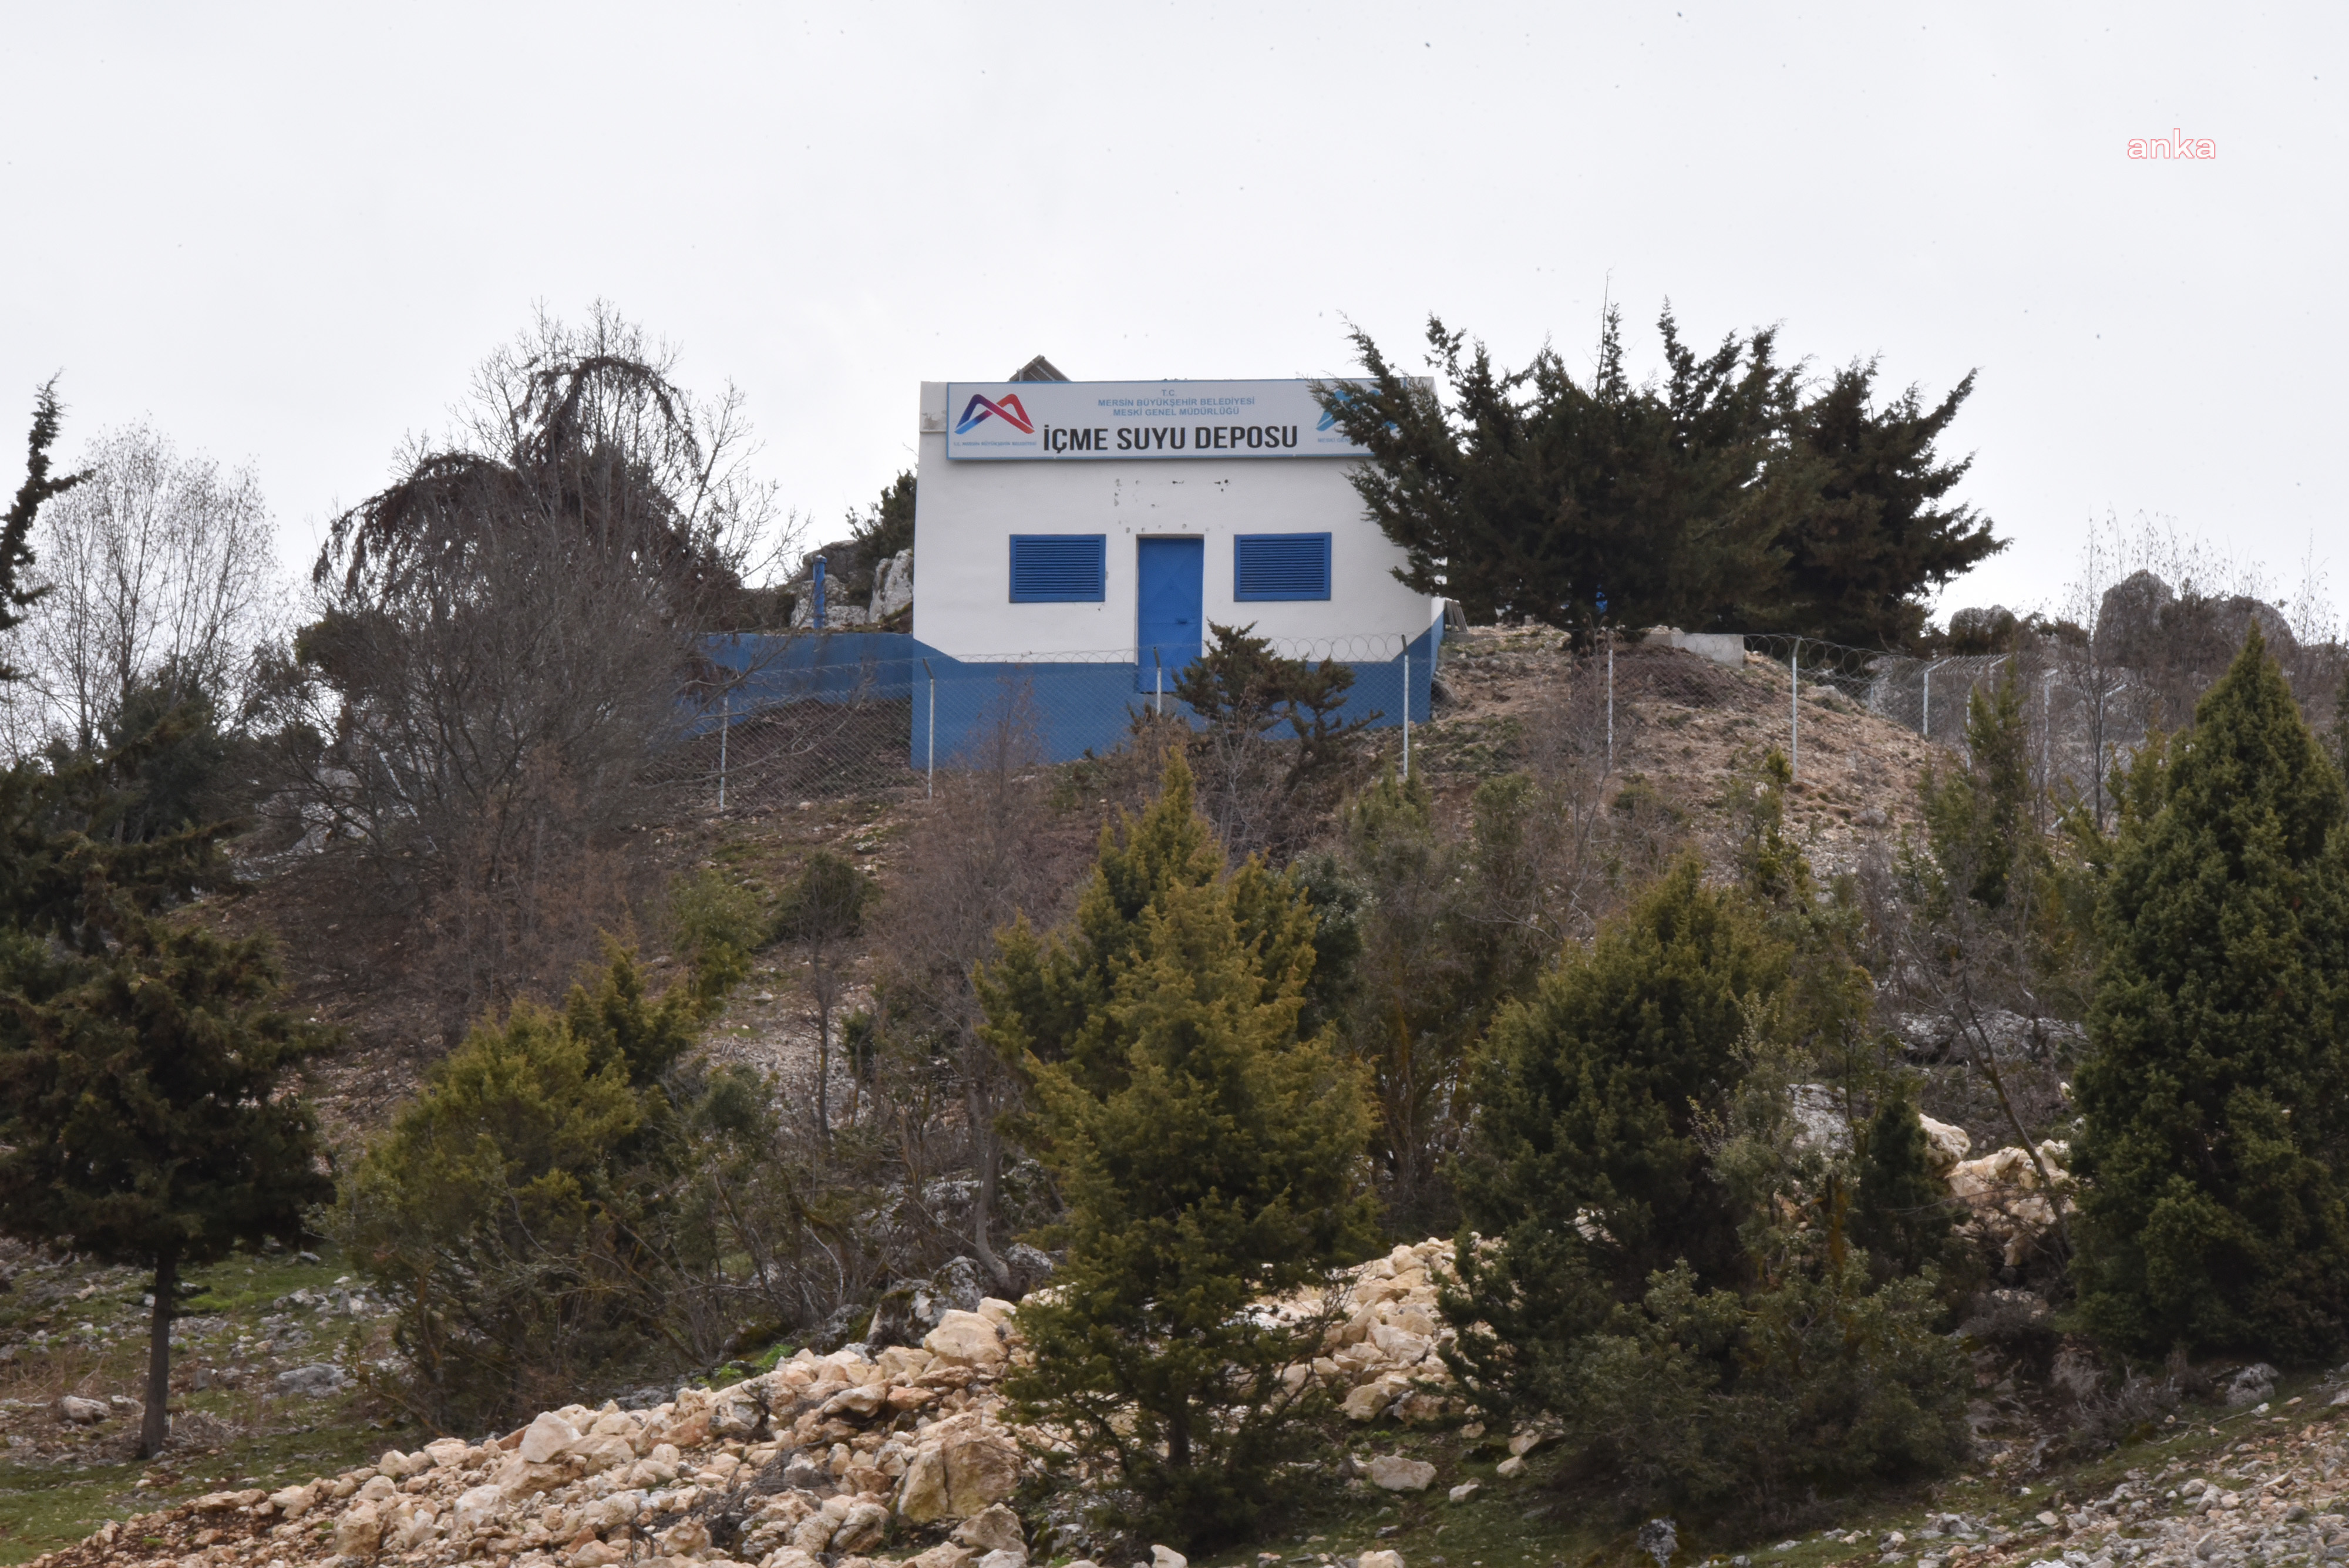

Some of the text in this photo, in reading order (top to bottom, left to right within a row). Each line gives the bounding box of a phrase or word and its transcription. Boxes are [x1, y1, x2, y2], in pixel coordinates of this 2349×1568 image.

[1098, 396, 1255, 408] MERSİN BÜYÜKŞEHİR BELEDİYESİ
[1113, 406, 1240, 416] MESKİ GENEL MÜDÜRLÜĞÜ
[1044, 424, 1298, 454] İÇME SUYU DEPOSU
